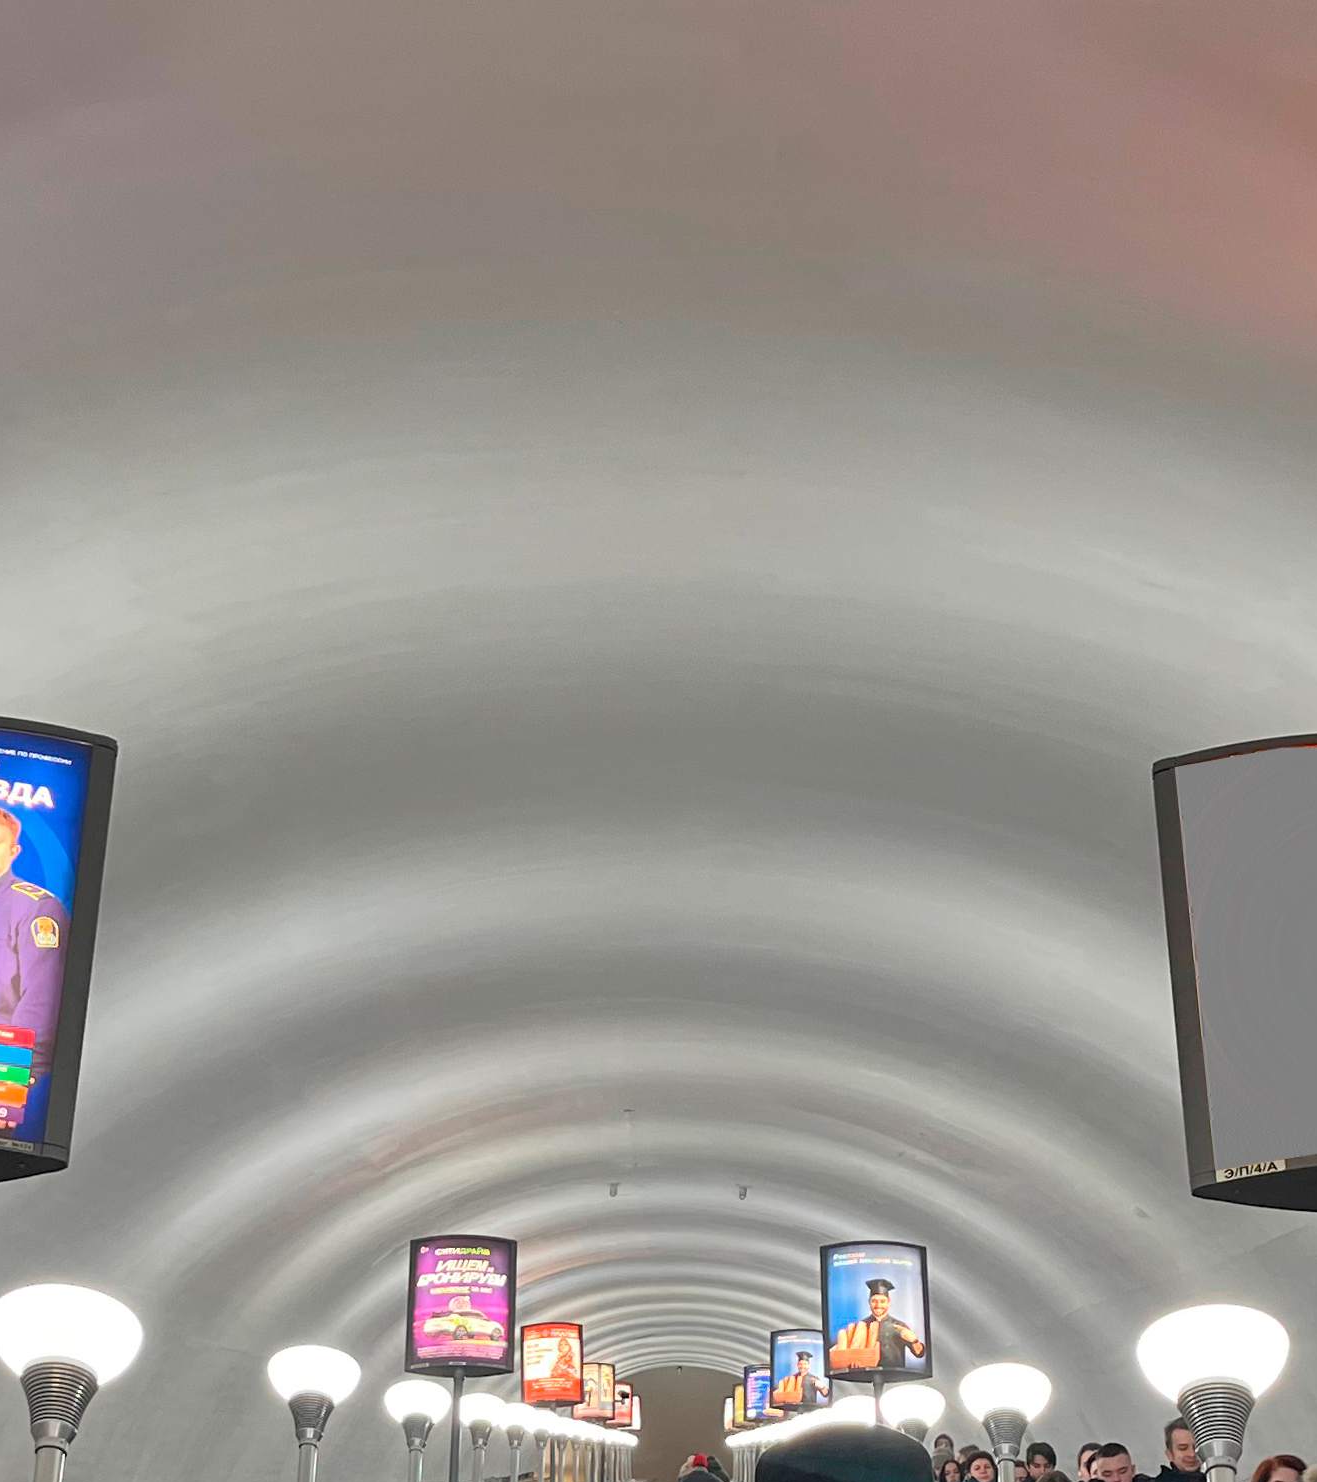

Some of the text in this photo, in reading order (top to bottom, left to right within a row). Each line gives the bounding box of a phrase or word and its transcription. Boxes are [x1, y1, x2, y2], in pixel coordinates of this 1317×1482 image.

[1224, 1162, 1278, 1179] Э/П/4/А
[435, 1247, 491, 1256] СИТИДРАЙВ
[435, 1260, 489, 1272] ИЩЕМ
[416, 1272, 507, 1287] БРОНИРУЕМ
